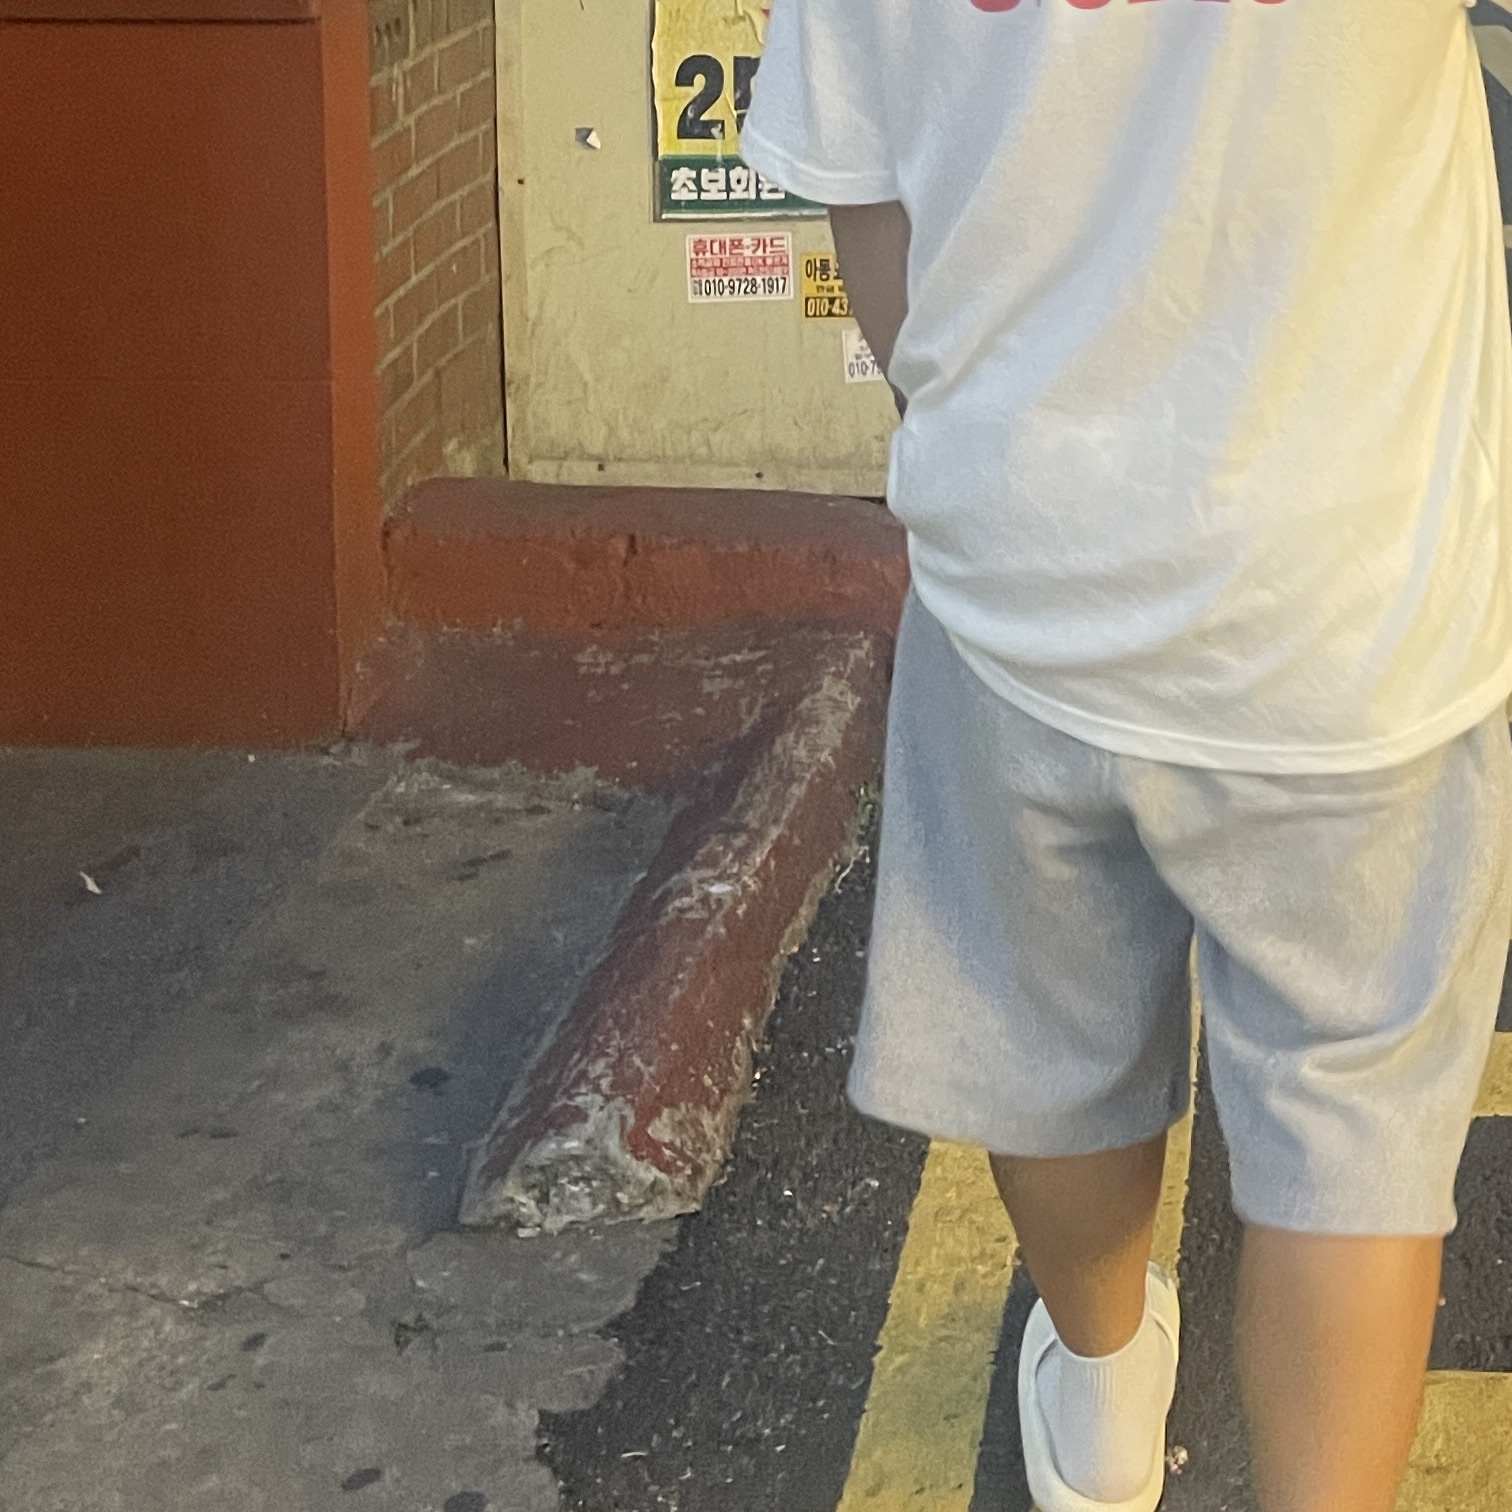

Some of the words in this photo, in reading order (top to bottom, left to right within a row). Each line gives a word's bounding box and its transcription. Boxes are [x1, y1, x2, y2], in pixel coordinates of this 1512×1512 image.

[704, 276, 787, 297] 010-9728-1917
[807, 298, 858, 318] 010-43
[848, 360, 882, 378] 010-7
